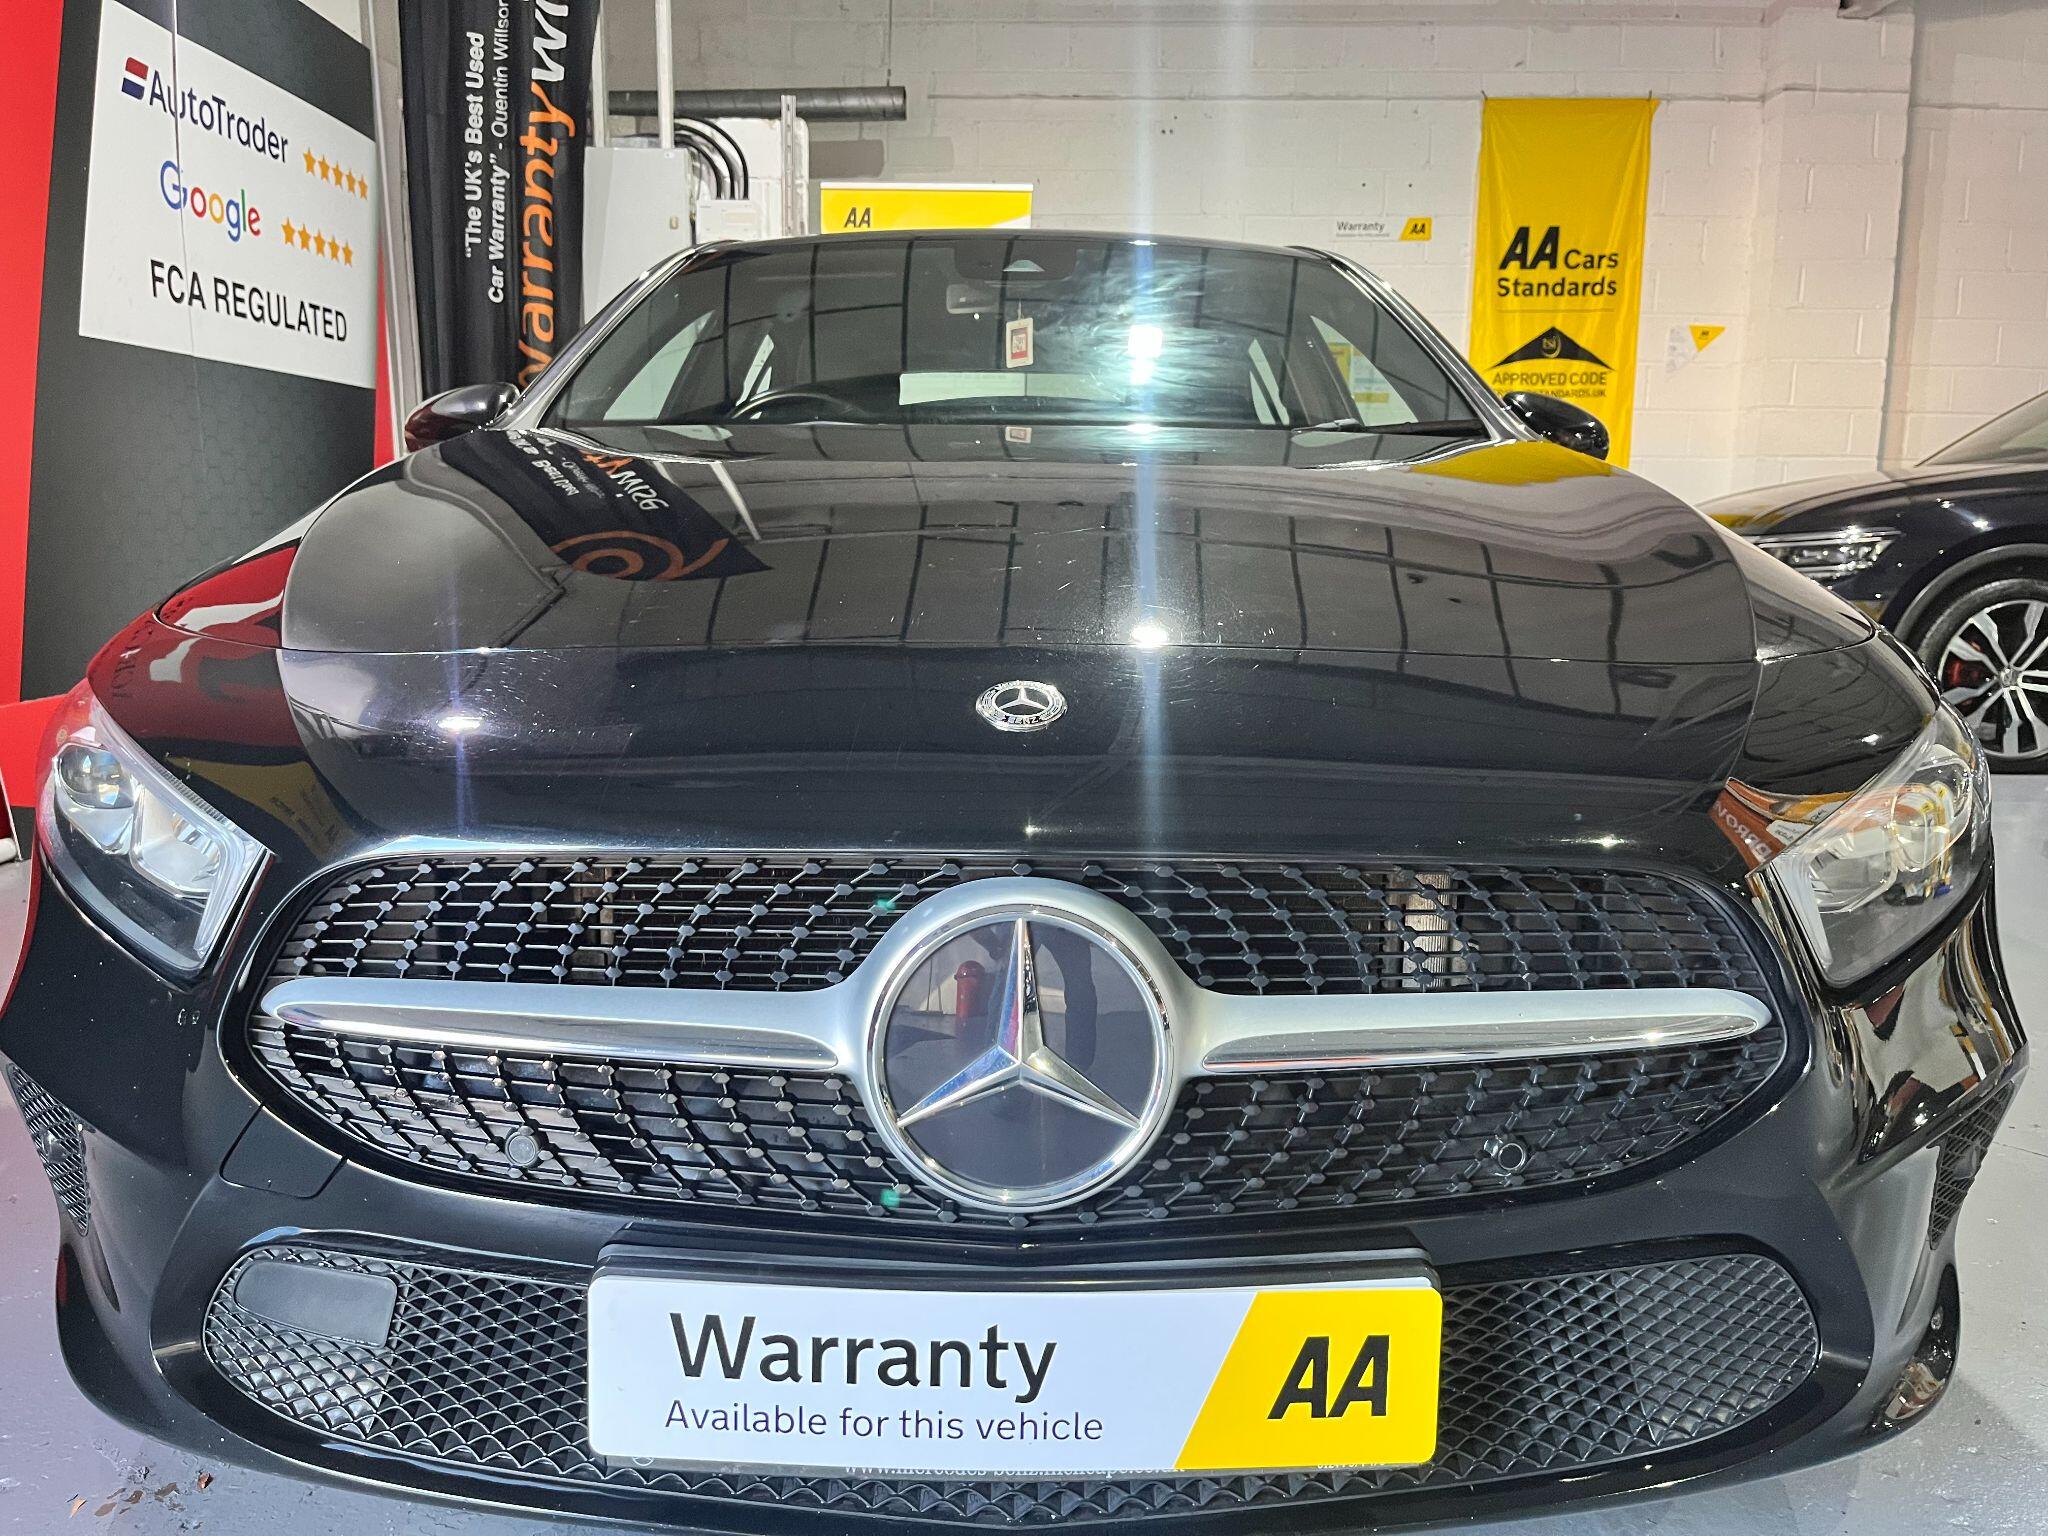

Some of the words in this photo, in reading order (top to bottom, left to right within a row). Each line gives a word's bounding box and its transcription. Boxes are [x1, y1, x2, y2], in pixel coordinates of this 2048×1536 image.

[465, 31, 485, 89] Used
[149, 69, 289, 164] AutoTrader
[464, 94, 485, 145] Best
[490, 66, 509, 138] Quentin
[160, 159, 262, 242] Google
[464, 150, 483, 201] UK's
[844, 207, 871, 229] AA
[1336, 221, 1386, 233] Warranty
[1410, 223, 1426, 234] AA
[1499, 226, 1560, 270] AA
[1563, 248, 1619, 270] Cars
[150, 259, 206, 310] FCA
[213, 277, 348, 342] REGULATED
[487, 265, 505, 304] Car
[1497, 276, 1617, 297] Standards
[1492, 372, 1567, 386] APPROVED
[1570, 372, 1607, 386] CODE
[671, 1312, 1058, 1404] Warranty
[1266, 1334, 1390, 1420] AA
[665, 1399, 827, 1437] Available
[839, 1406, 890, 1438] for
[898, 1409, 964, 1440] this
[975, 1411, 1103, 1442] vehicle
